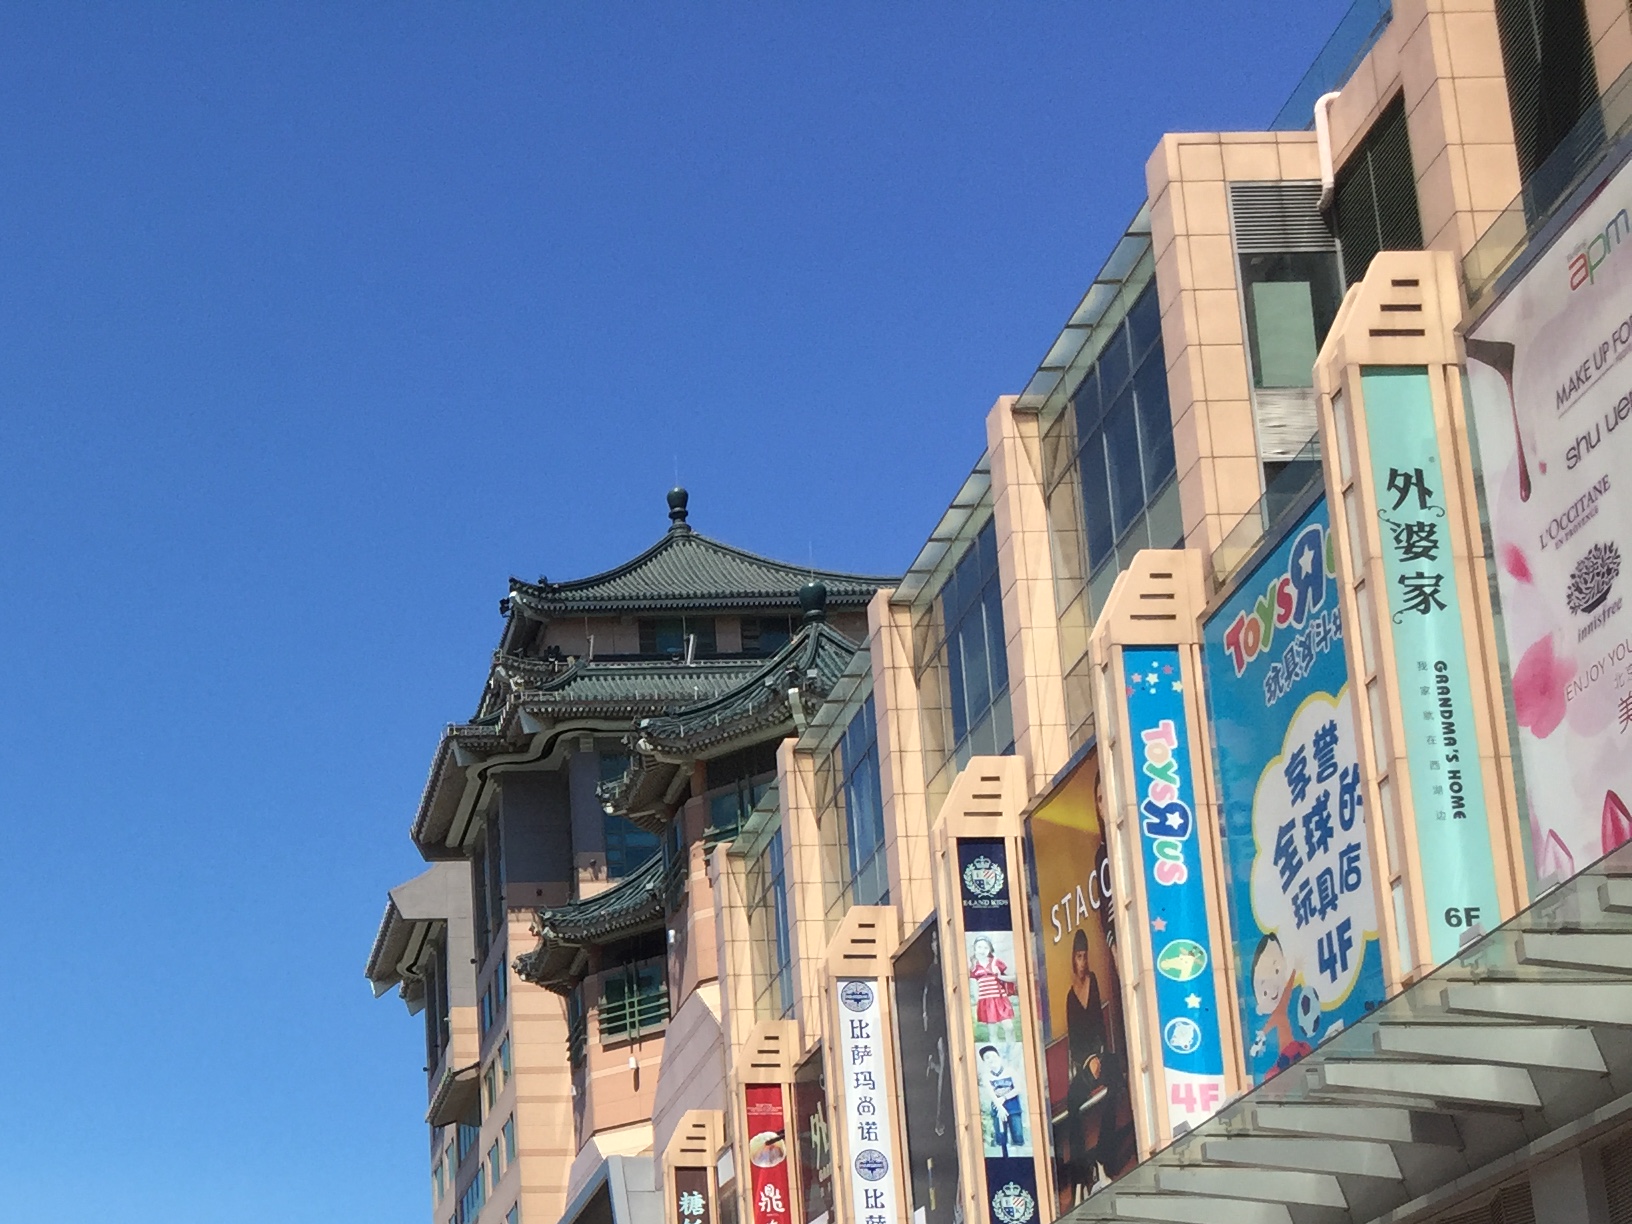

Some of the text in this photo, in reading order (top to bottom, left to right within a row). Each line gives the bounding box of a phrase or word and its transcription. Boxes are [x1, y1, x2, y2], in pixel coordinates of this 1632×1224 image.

[1568, 208, 1630, 291] apm
[1556, 314, 1632, 410] MAKE UP FO
[1566, 390, 1632, 470] shu ue
[1378, 467, 1448, 622] 外婆家
[1539, 474, 1611, 550] L'OCCITANE
[1578, 598, 1623, 643] innisfree
[1566, 657, 1606, 702] ENJOY
[1434, 660, 1467, 819] GRANDMA'S HOME
[1291, 841, 1362, 930] 玩具店
[1444, 906, 1481, 928] 6F
[1317, 916, 1352, 984] 4F
[849, 1018, 879, 1143] 比萨玛尚诺
[1171, 1083, 1220, 1116] 4F
